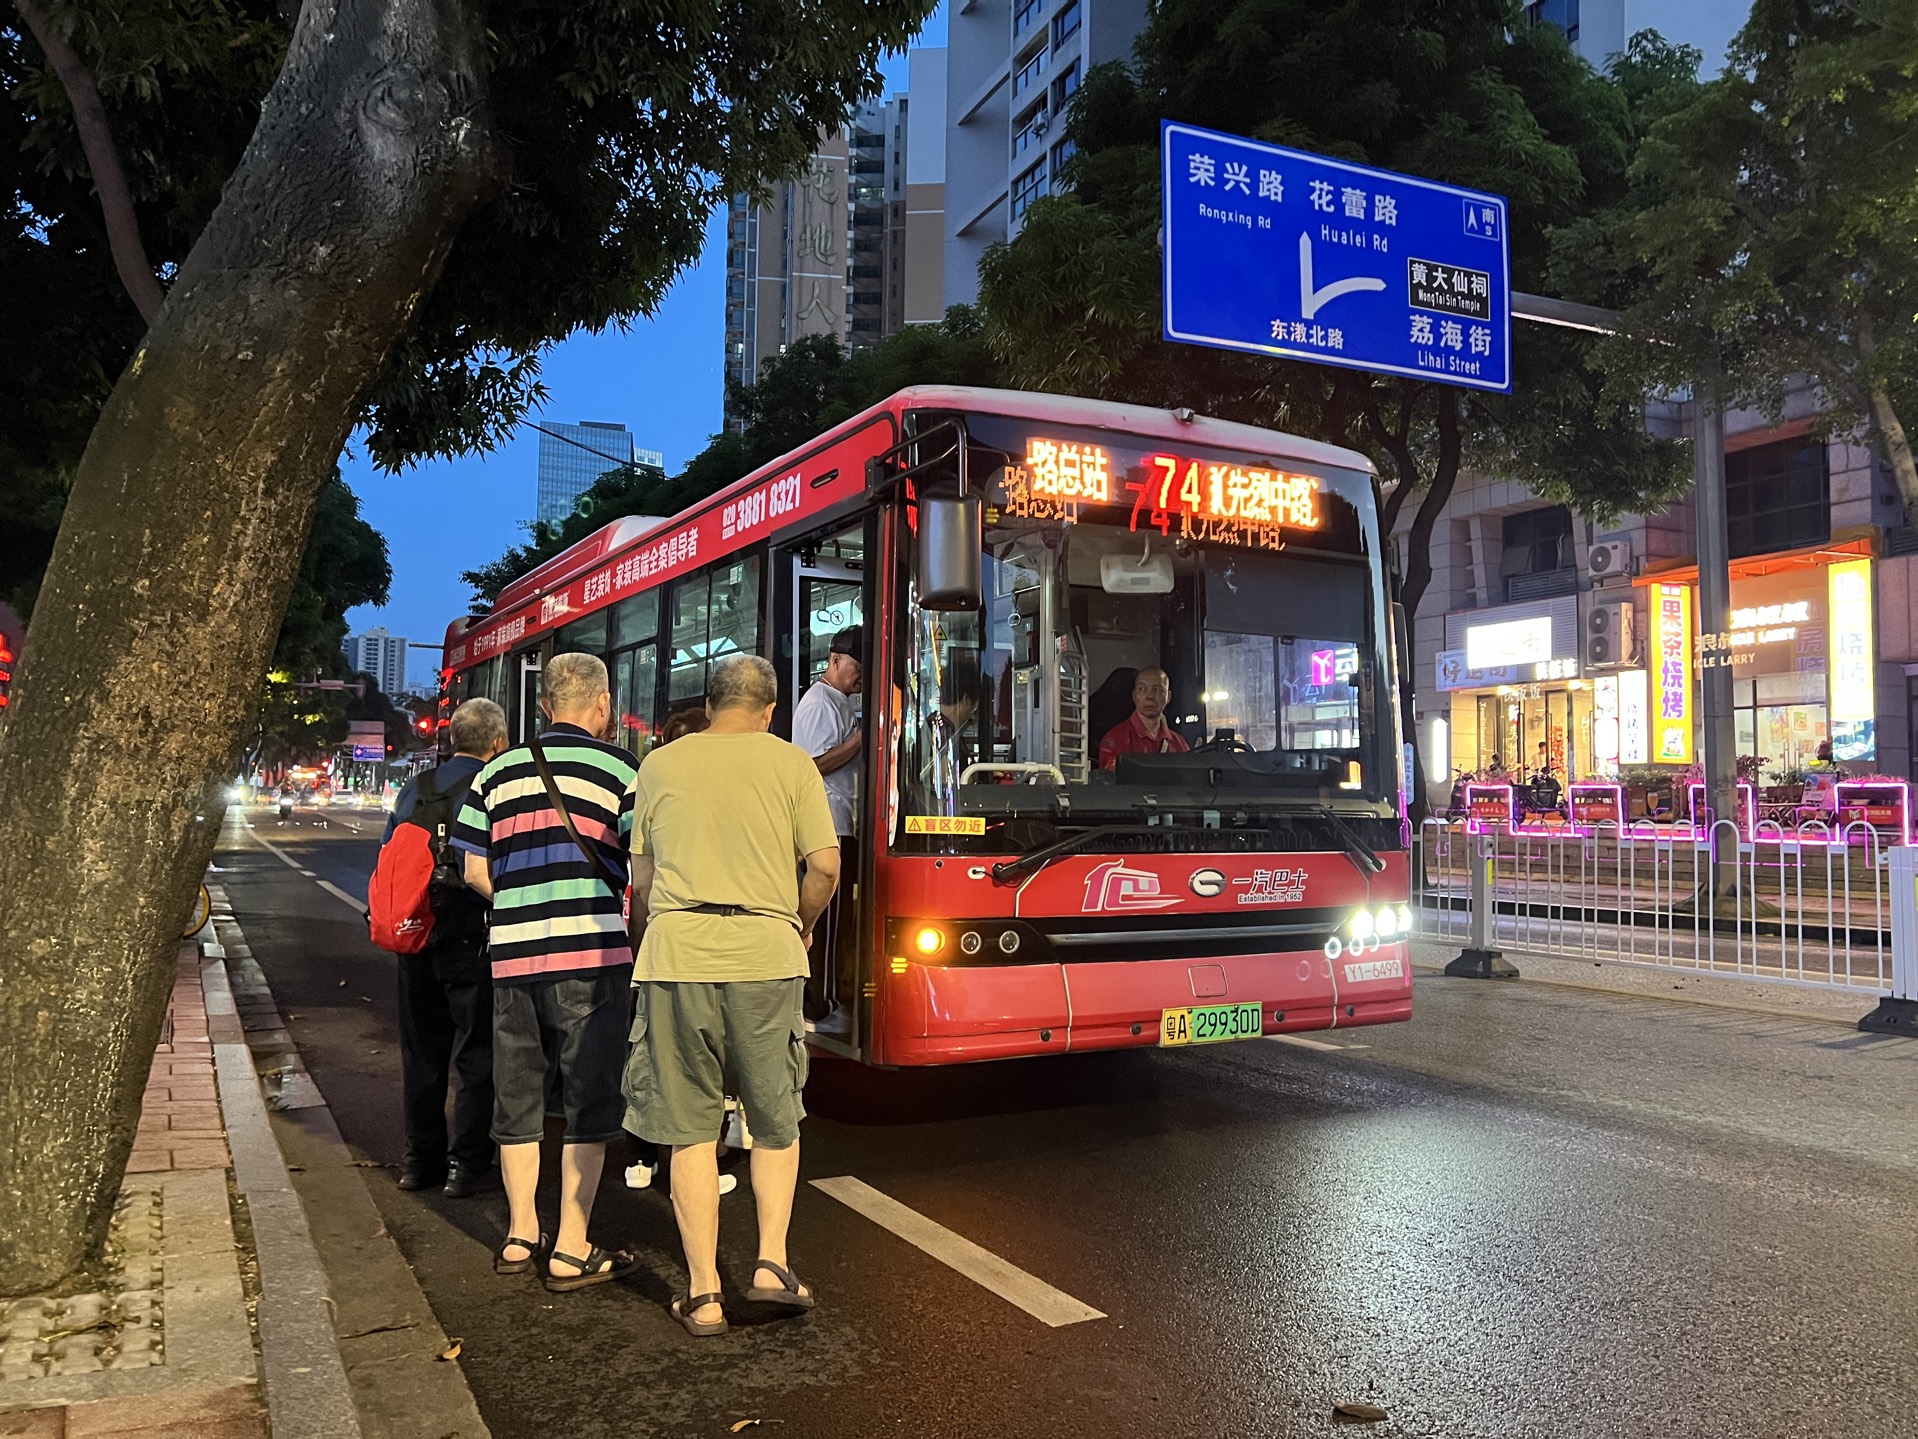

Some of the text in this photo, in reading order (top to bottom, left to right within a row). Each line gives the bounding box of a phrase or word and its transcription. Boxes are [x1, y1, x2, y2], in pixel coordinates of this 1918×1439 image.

[1188, 153, 1398, 226] 荣兴路 花蕾路
[1199, 203, 1271, 229] Rongxing Rd
[1481, 207, 1495, 225] 南
[1321, 223, 1388, 253] Hualei Rd
[1485, 225, 1493, 236] S
[1411, 262, 1487, 298] 黄大仙祠
[1409, 314, 1491, 357] 荔海街
[1418, 350, 1480, 376] Lihai Street
[1155, 456, 1201, 513] 74
[722, 472, 801, 533] 020 3881 8321
[1661, 600, 1683, 719] 果茶烧烤
[1720, 652, 1756, 668] LARRY
[924, 818, 982, 833] 盲区勿近
[1232, 868, 1308, 893] 一汽巴士
[1239, 894, 1277, 903] Established
[1348, 961, 1399, 980] Y1-6499
[1165, 1007, 1260, 1042] 粤A 29930D
